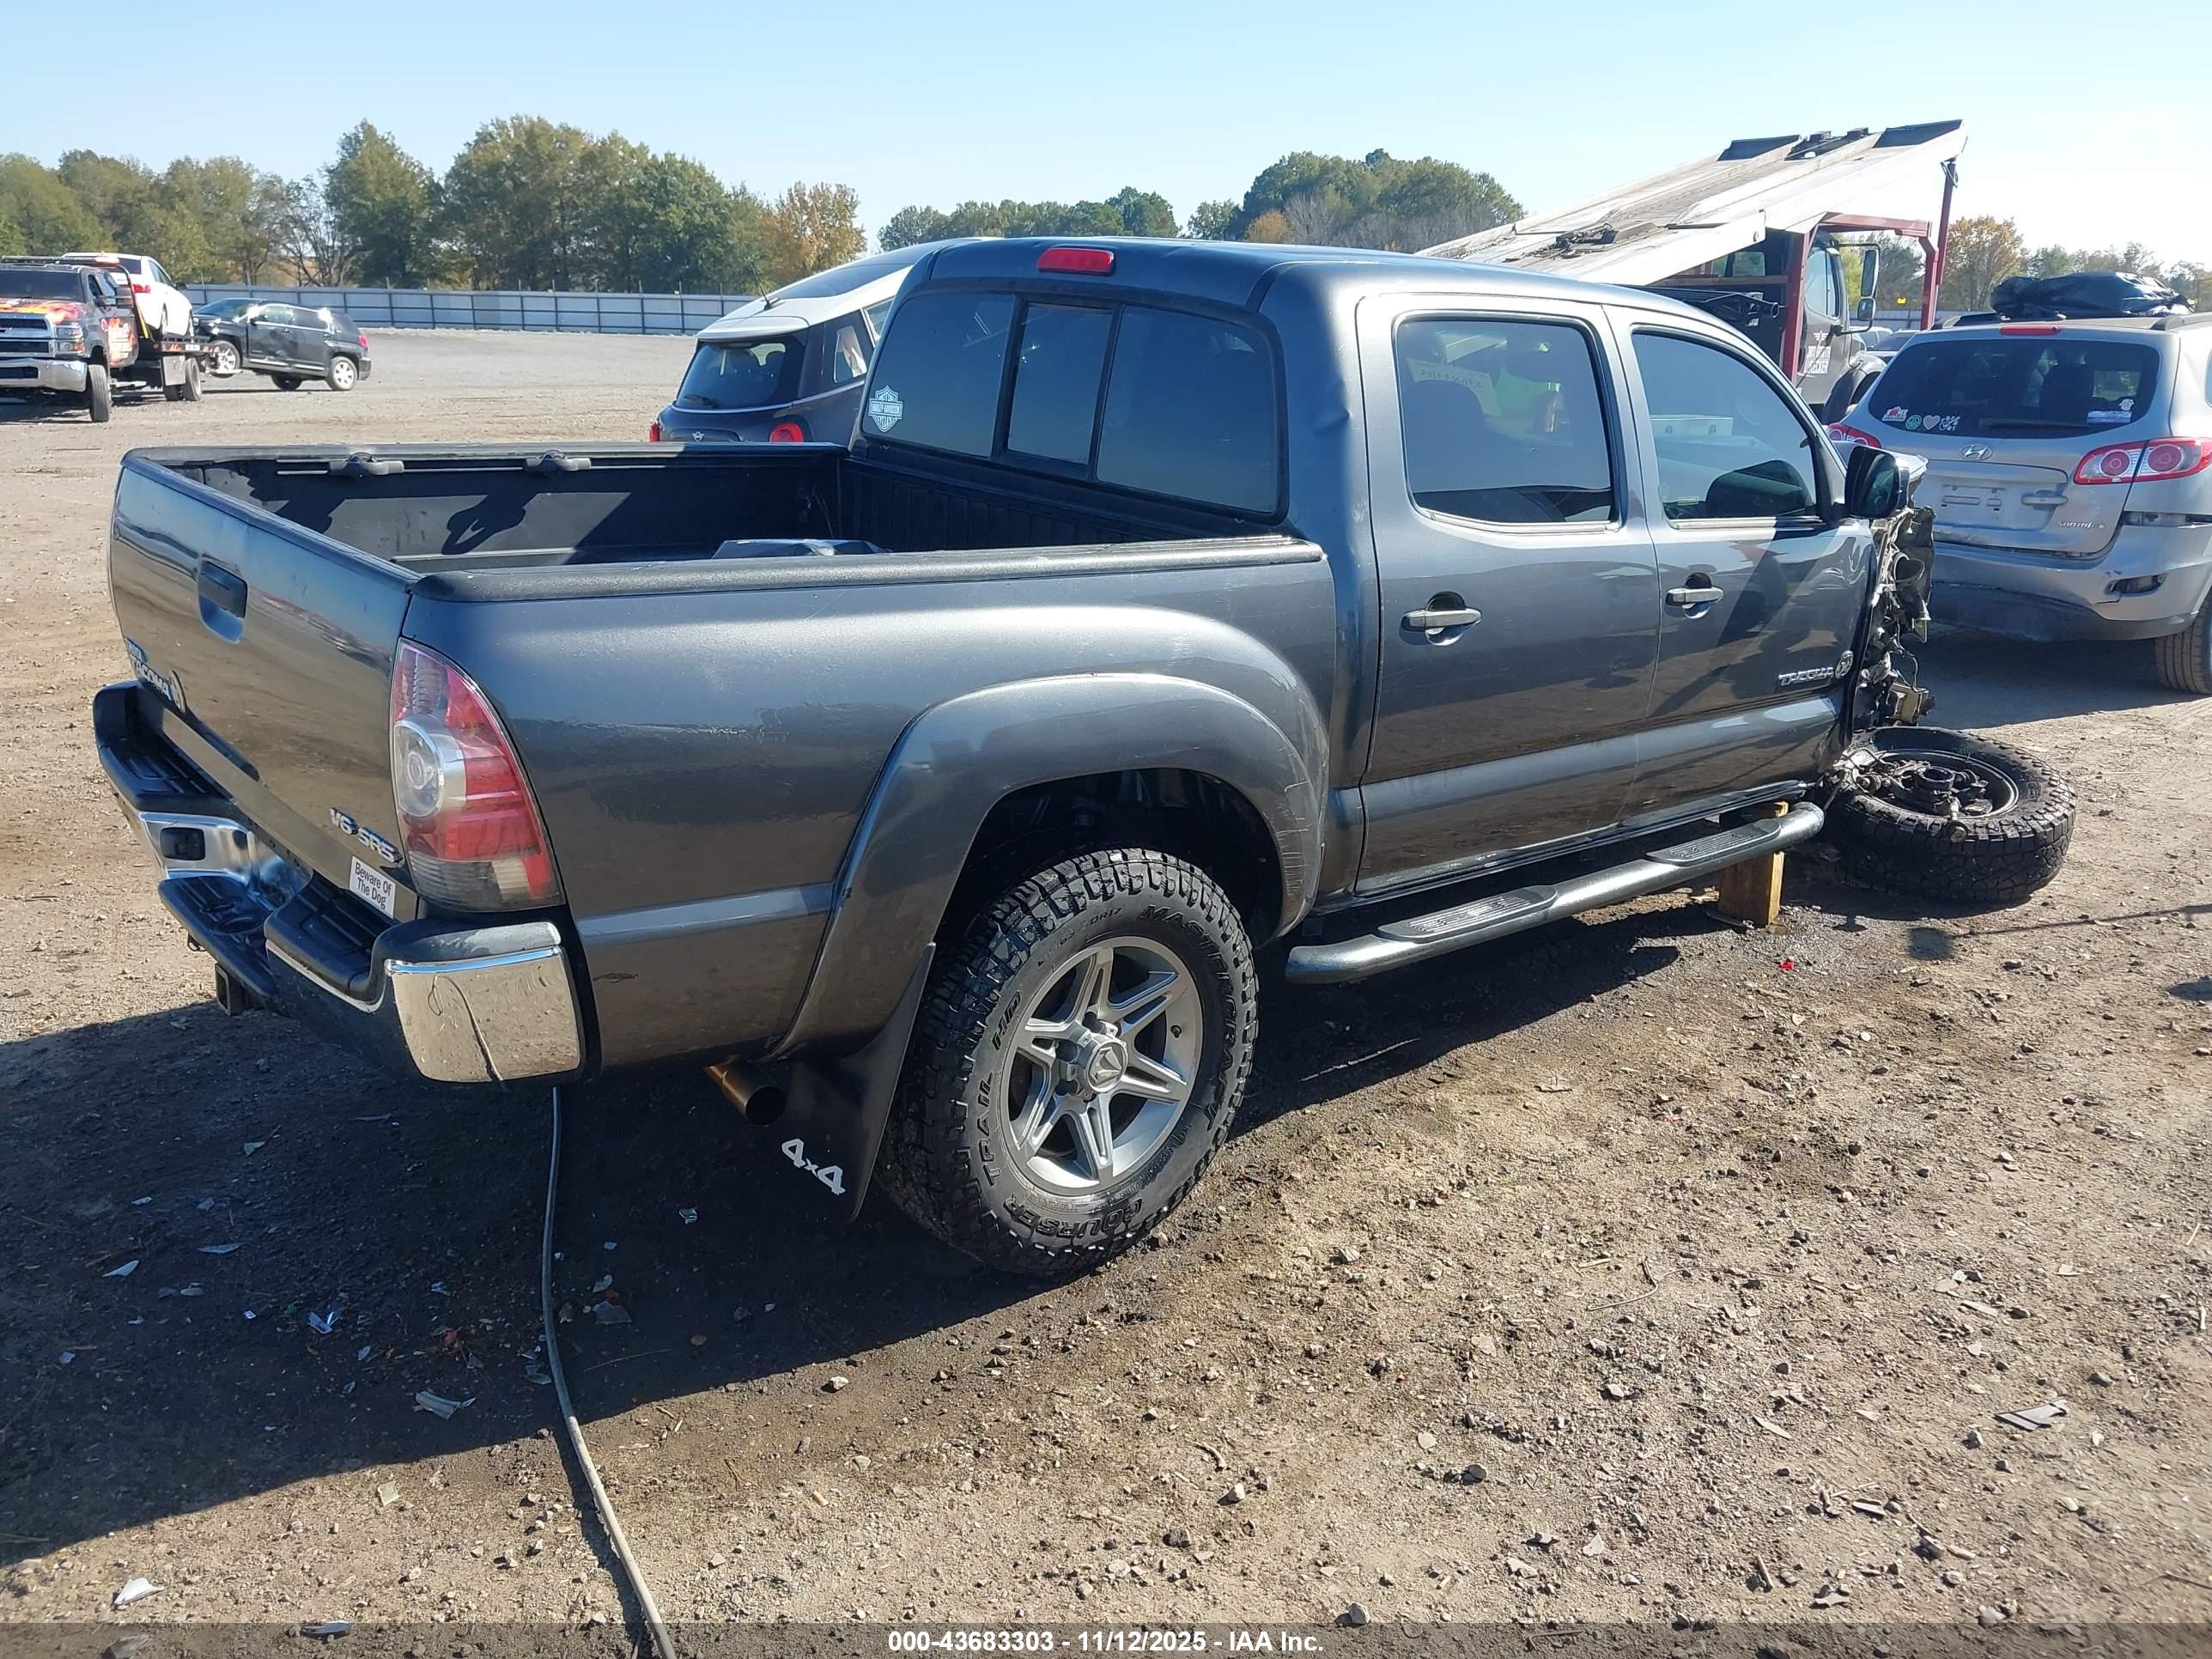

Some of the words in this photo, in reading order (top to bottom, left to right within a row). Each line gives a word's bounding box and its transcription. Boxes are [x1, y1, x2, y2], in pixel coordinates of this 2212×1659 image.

[330, 807, 357, 836] V6
[357, 827, 401, 864] SR5
[355, 862, 382, 890] Beware
[382, 880, 392, 897] Of
[357, 877, 371, 896] The
[371, 887, 387, 910] Dog
[976, 1072, 1002, 1188] TRAIL
[781, 1138, 846, 1195] 4x4
[1002, 1194, 1143, 1239] COURSER
